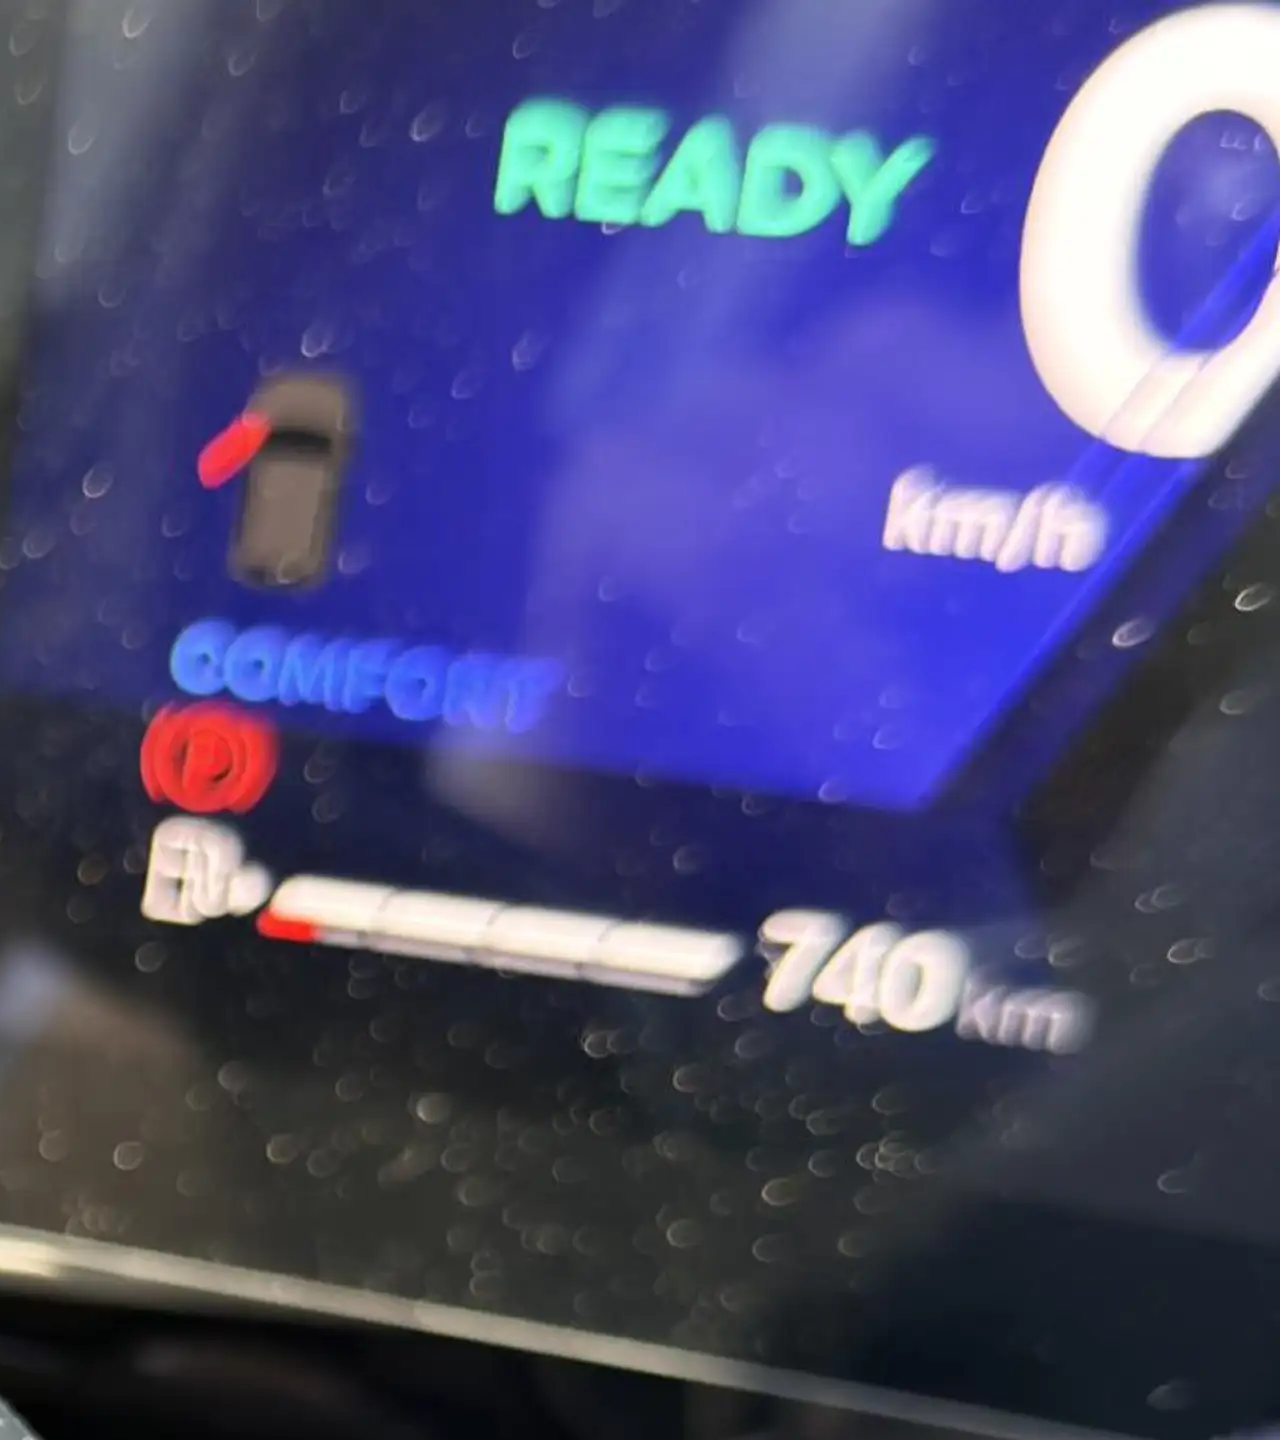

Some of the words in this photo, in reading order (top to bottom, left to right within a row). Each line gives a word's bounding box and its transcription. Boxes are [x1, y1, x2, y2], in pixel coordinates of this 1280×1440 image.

[494, 98, 932, 246] READY
[1020, 2, 1280, 458] 0
[880, 464, 1108, 574] km/h
[758, 908, 970, 1034] 740
